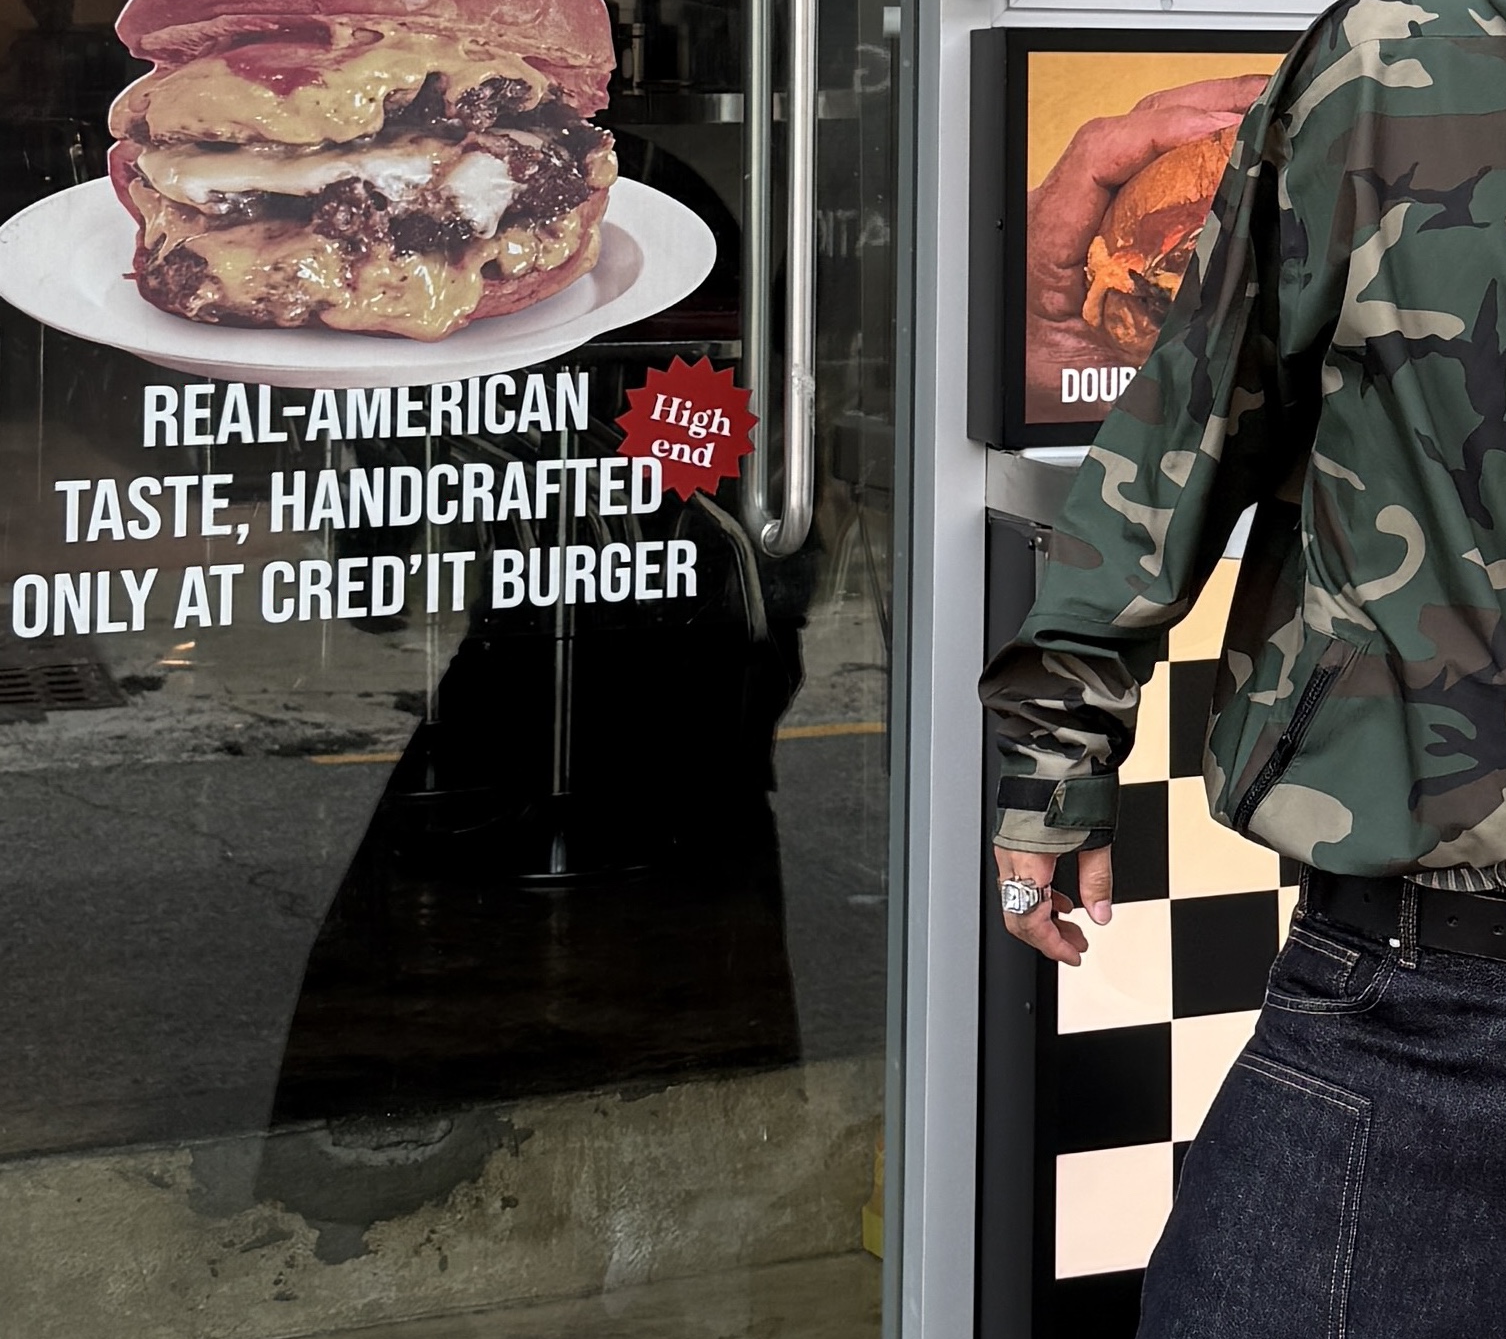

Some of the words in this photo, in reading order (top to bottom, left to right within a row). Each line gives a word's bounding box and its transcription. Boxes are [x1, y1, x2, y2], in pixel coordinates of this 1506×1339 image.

[143, 372, 589, 448] REAL-AMERICAN
[650, 394, 733, 438] High
[652, 432, 714, 469] end
[56, 473, 251, 546] TASTE,
[270, 456, 662, 533] HANDCRAFTED
[12, 571, 157, 640] ONLY
[174, 564, 244, 629] AT
[262, 550, 476, 625] CRED'IT
[493, 539, 699, 608] BURGER
